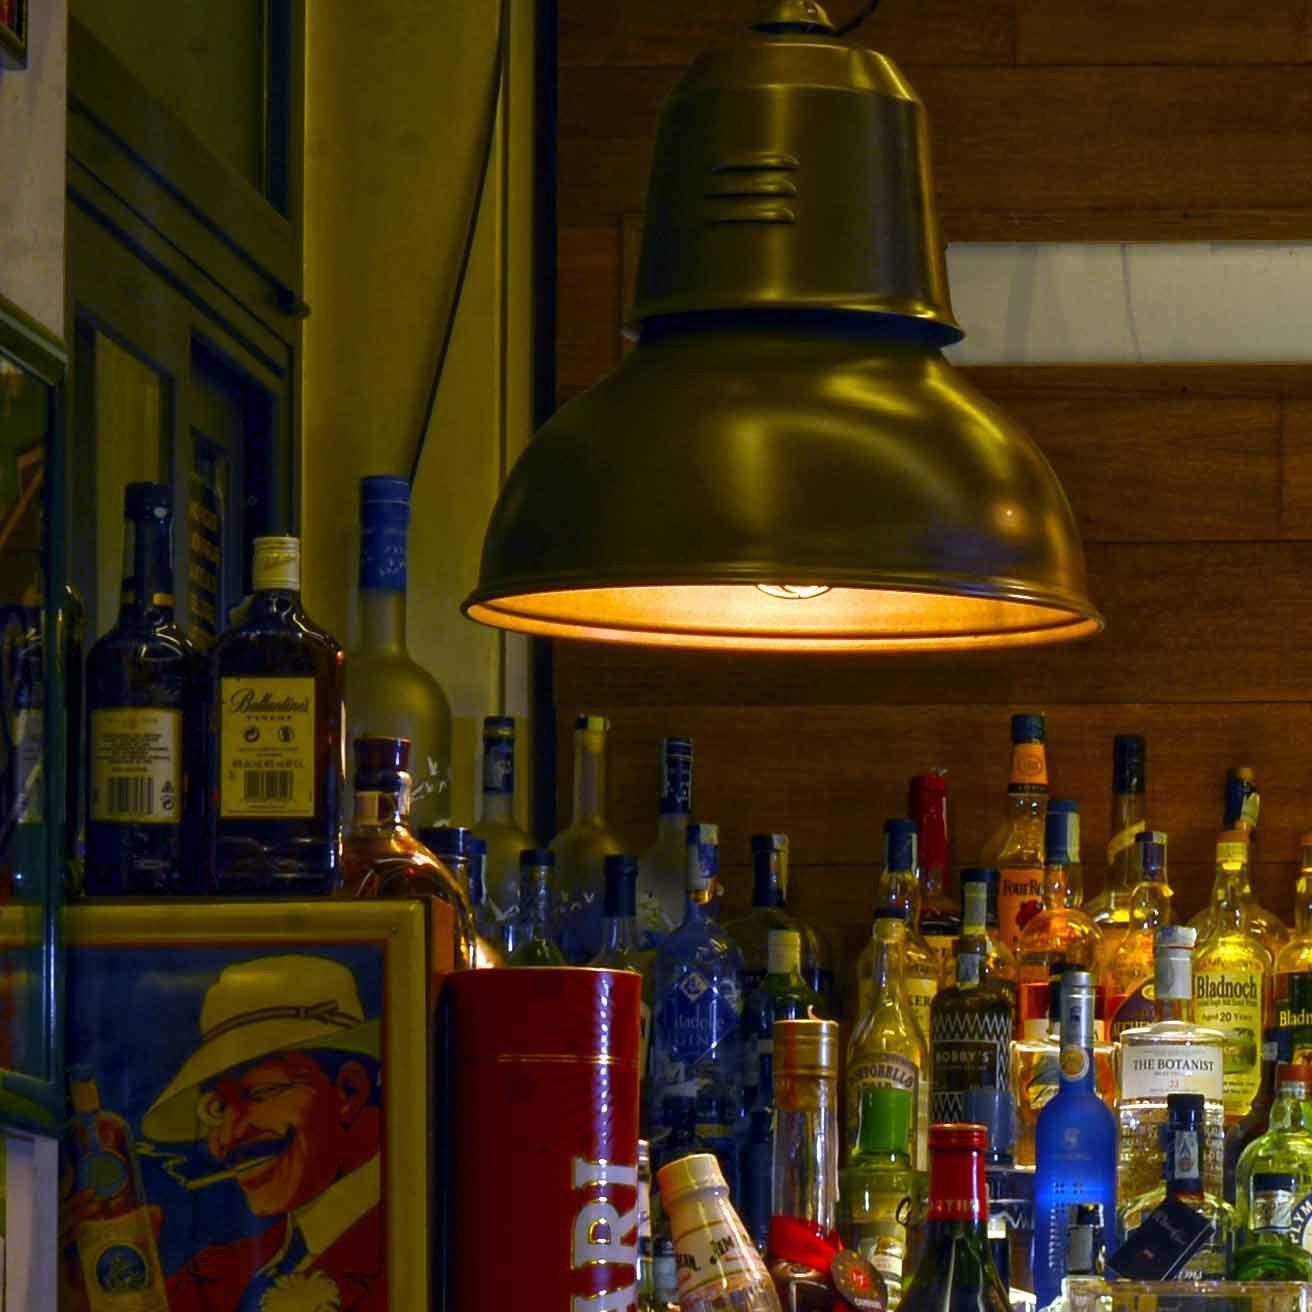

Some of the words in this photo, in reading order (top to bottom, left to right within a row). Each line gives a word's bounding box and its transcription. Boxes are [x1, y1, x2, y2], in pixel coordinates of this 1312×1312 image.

[1195, 975, 1258, 1000] Bladnoch
[1219, 1010, 1232, 1023] 20
[1133, 1059, 1155, 1072] THE
[1157, 1058, 1216, 1073] BOTANIST
